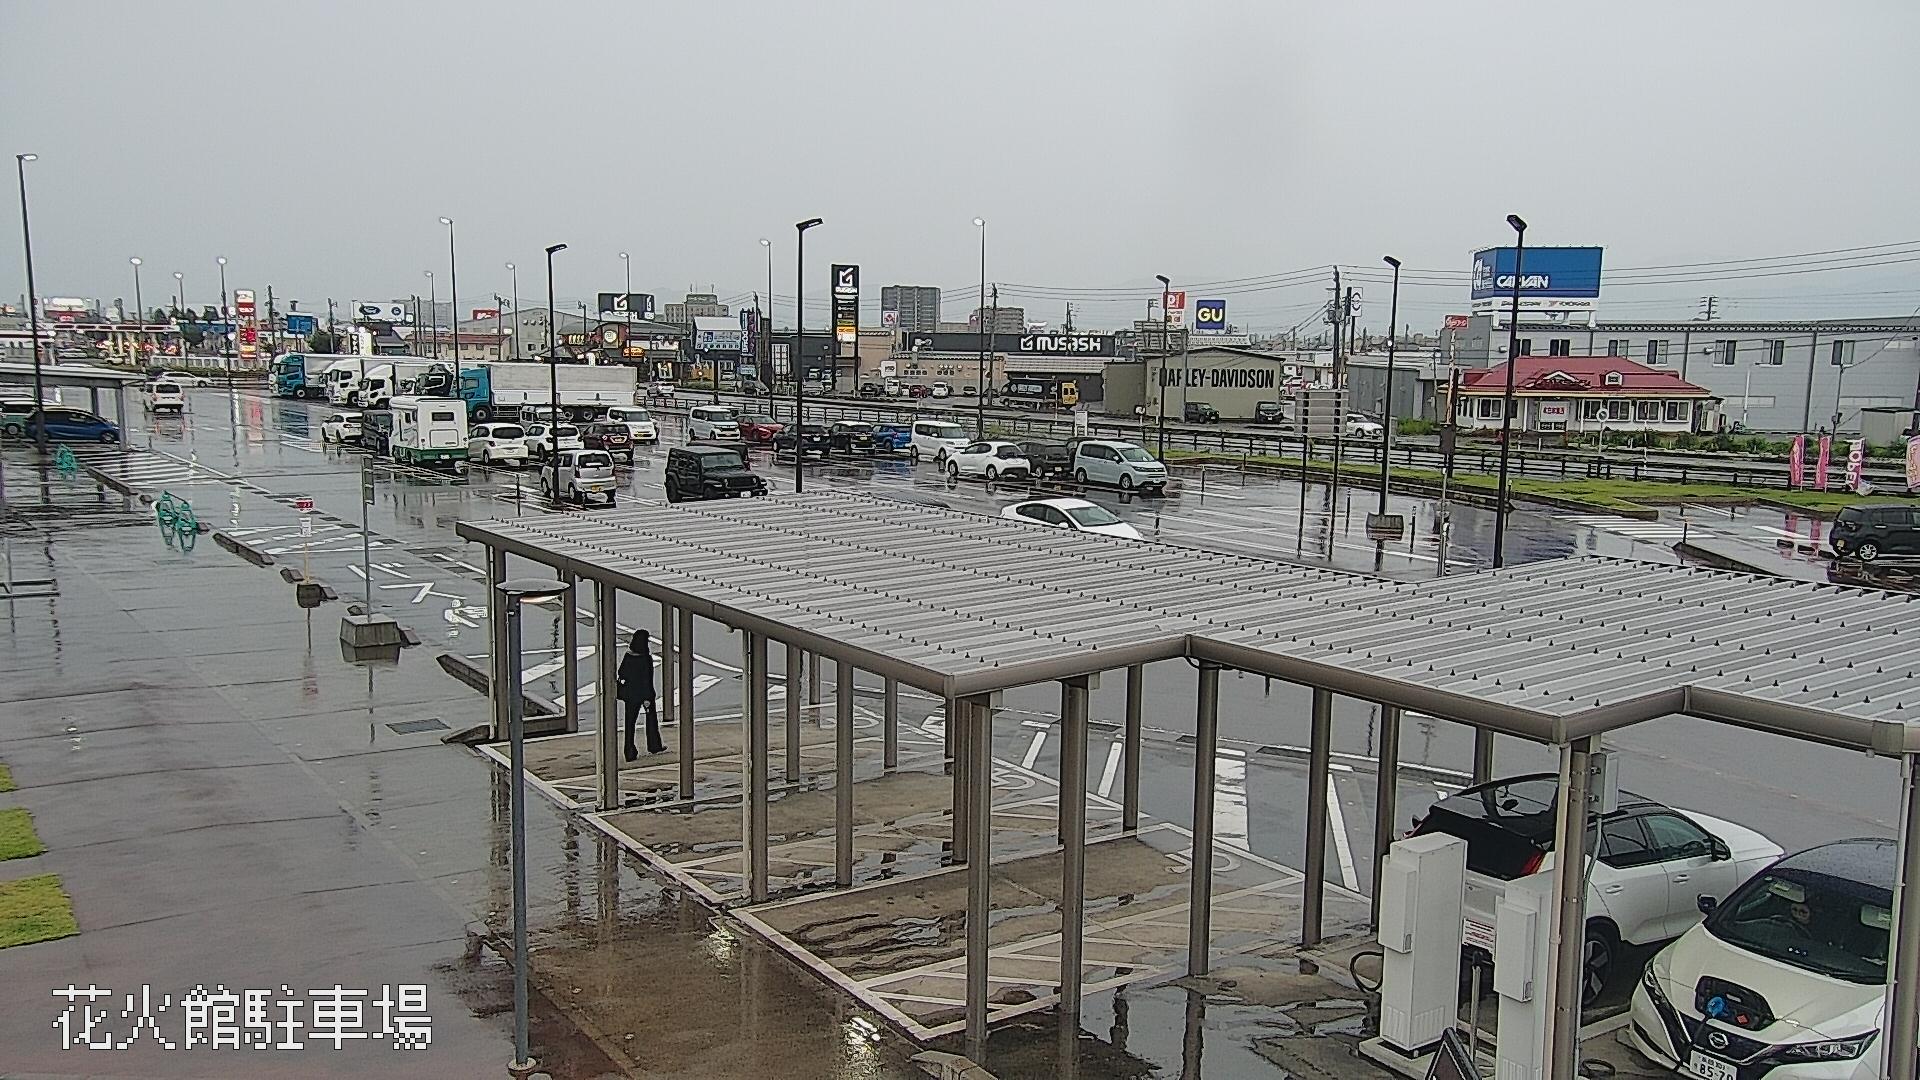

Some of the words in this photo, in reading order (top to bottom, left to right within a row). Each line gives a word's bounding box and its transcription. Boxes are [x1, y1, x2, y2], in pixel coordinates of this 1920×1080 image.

[1496, 276, 1549, 289] CARVAN
[1197, 307, 1223, 322] GU
[1159, 368, 1275, 388] ARLEY-DAVIDSON
